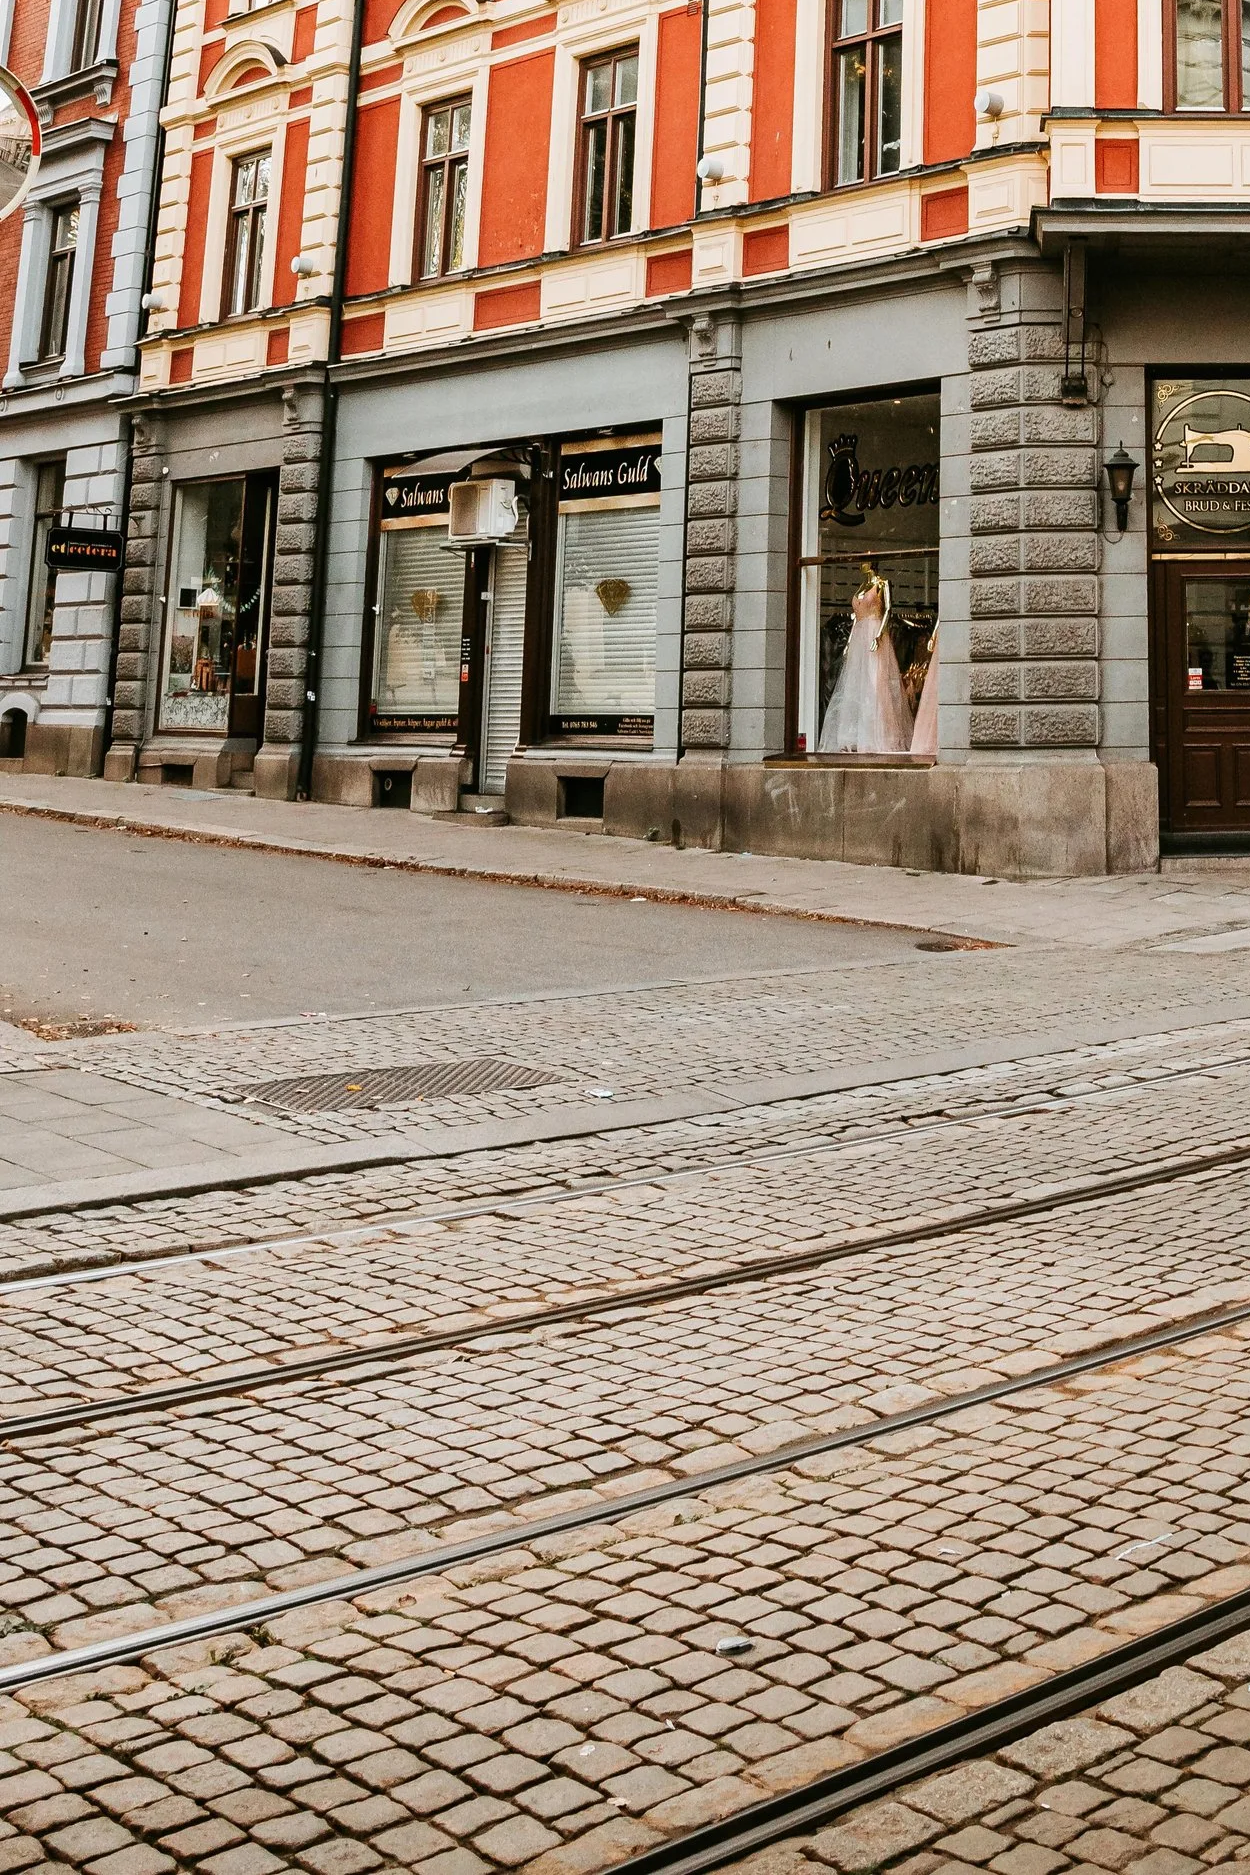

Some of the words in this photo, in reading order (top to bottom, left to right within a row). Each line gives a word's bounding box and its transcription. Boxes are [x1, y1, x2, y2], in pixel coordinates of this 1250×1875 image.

[563, 462, 614, 490] Salwans
[617, 455, 652, 484] Guld
[819, 443, 940, 526] Queen
[401, 482, 444, 508] Salwans
[1185, 500, 1219, 511] BRUD
[1222, 501, 1230, 510] &
